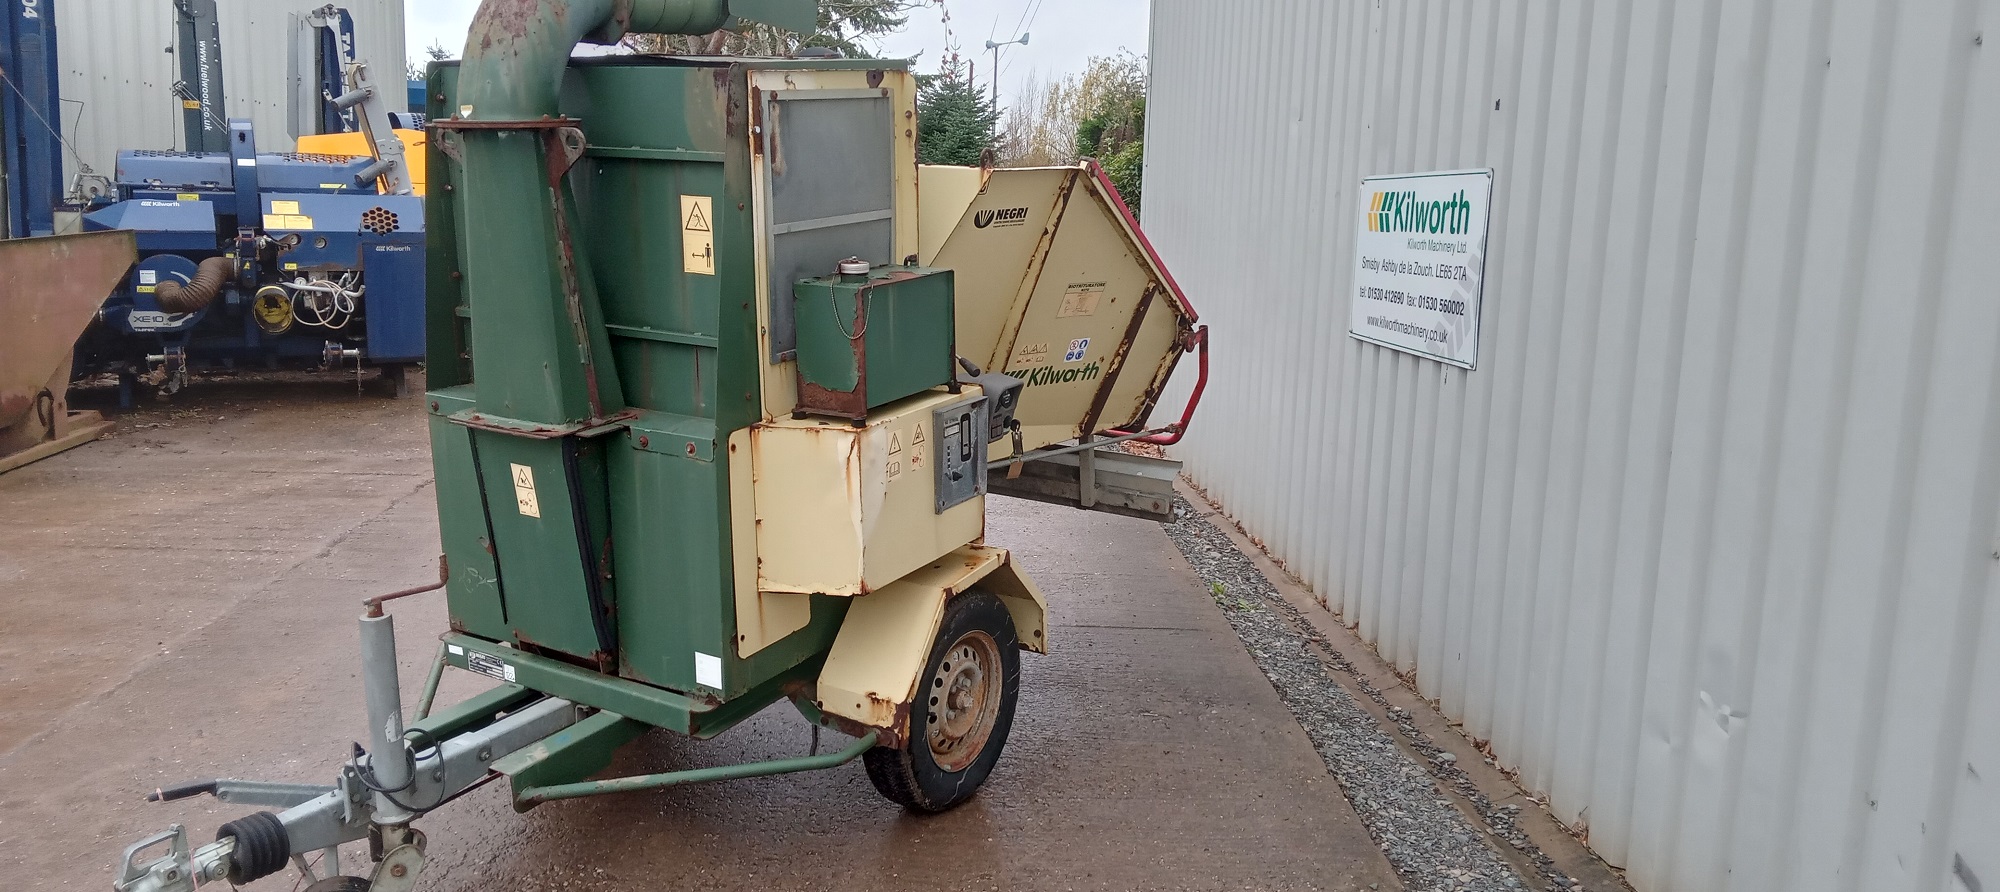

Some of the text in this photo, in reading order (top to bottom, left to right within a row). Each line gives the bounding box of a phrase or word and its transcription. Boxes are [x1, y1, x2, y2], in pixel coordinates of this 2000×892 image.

[199, 40, 213, 131] www.fuelwood.co.uk
[995, 207, 1029, 220] NEGRI
[1394, 189, 1470, 235] Kilworth
[1407, 238, 1467, 256] Kilworth Machinery Ltd.
[1362, 256, 1467, 281] Smisby Ashby de la Zouch. LE65 2TA
[1367, 287, 1383, 301] 01530
[1384, 289, 1404, 305] 412690
[1406, 292, 1417, 307] fax:
[1418, 295, 1437, 311] 01530
[1439, 298, 1465, 316] 560002
[1367, 315, 1448, 343] www.kilworthmachinery.co.uk
[1027, 361, 1099, 388] Kilworth
